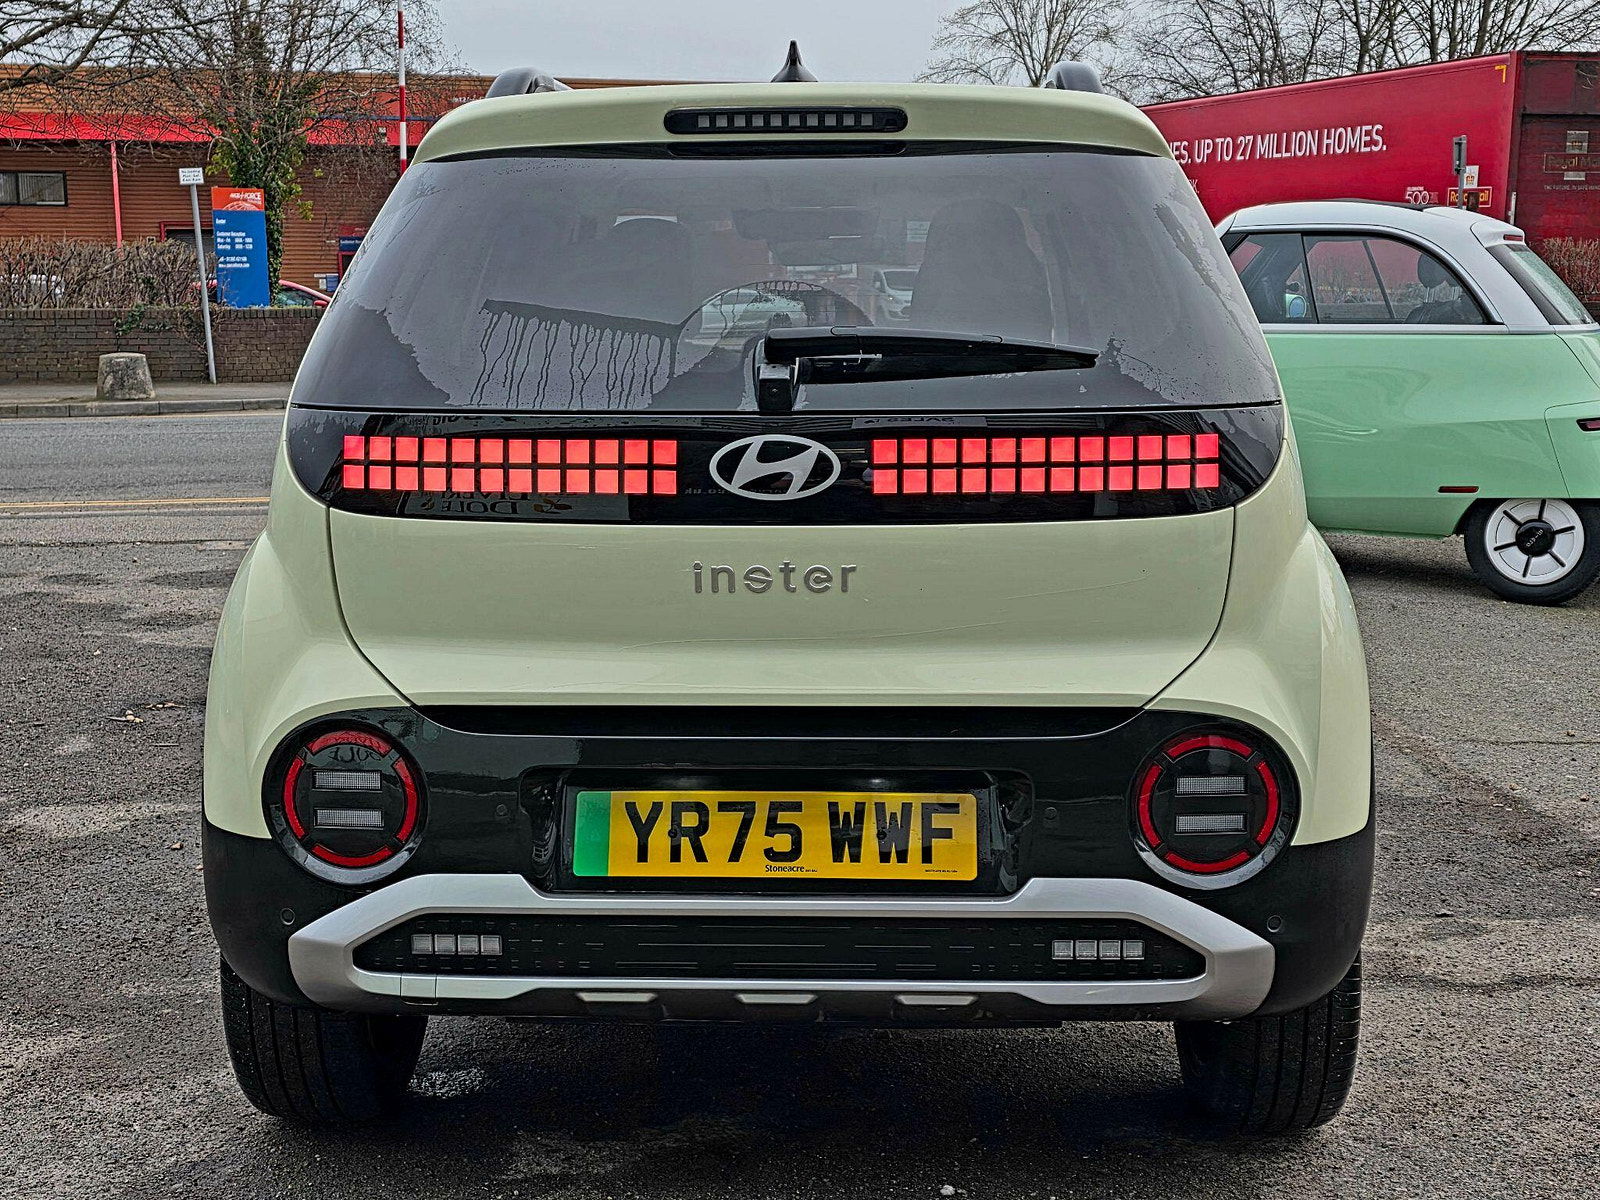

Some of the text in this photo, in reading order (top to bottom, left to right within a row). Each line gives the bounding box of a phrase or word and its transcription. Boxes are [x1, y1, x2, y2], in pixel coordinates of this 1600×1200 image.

[1195, 138, 1213, 164] UP
[1216, 137, 1233, 162] TO
[1236, 135, 1254, 161] 27
[1256, 129, 1319, 160] MILLION
[1322, 124, 1387, 155] HOMES.
[1405, 191, 1430, 204] 500
[692, 560, 857, 594] inster
[624, 801, 961, 865] YR75 WWF
[765, 864, 805, 873] Stoneacre
